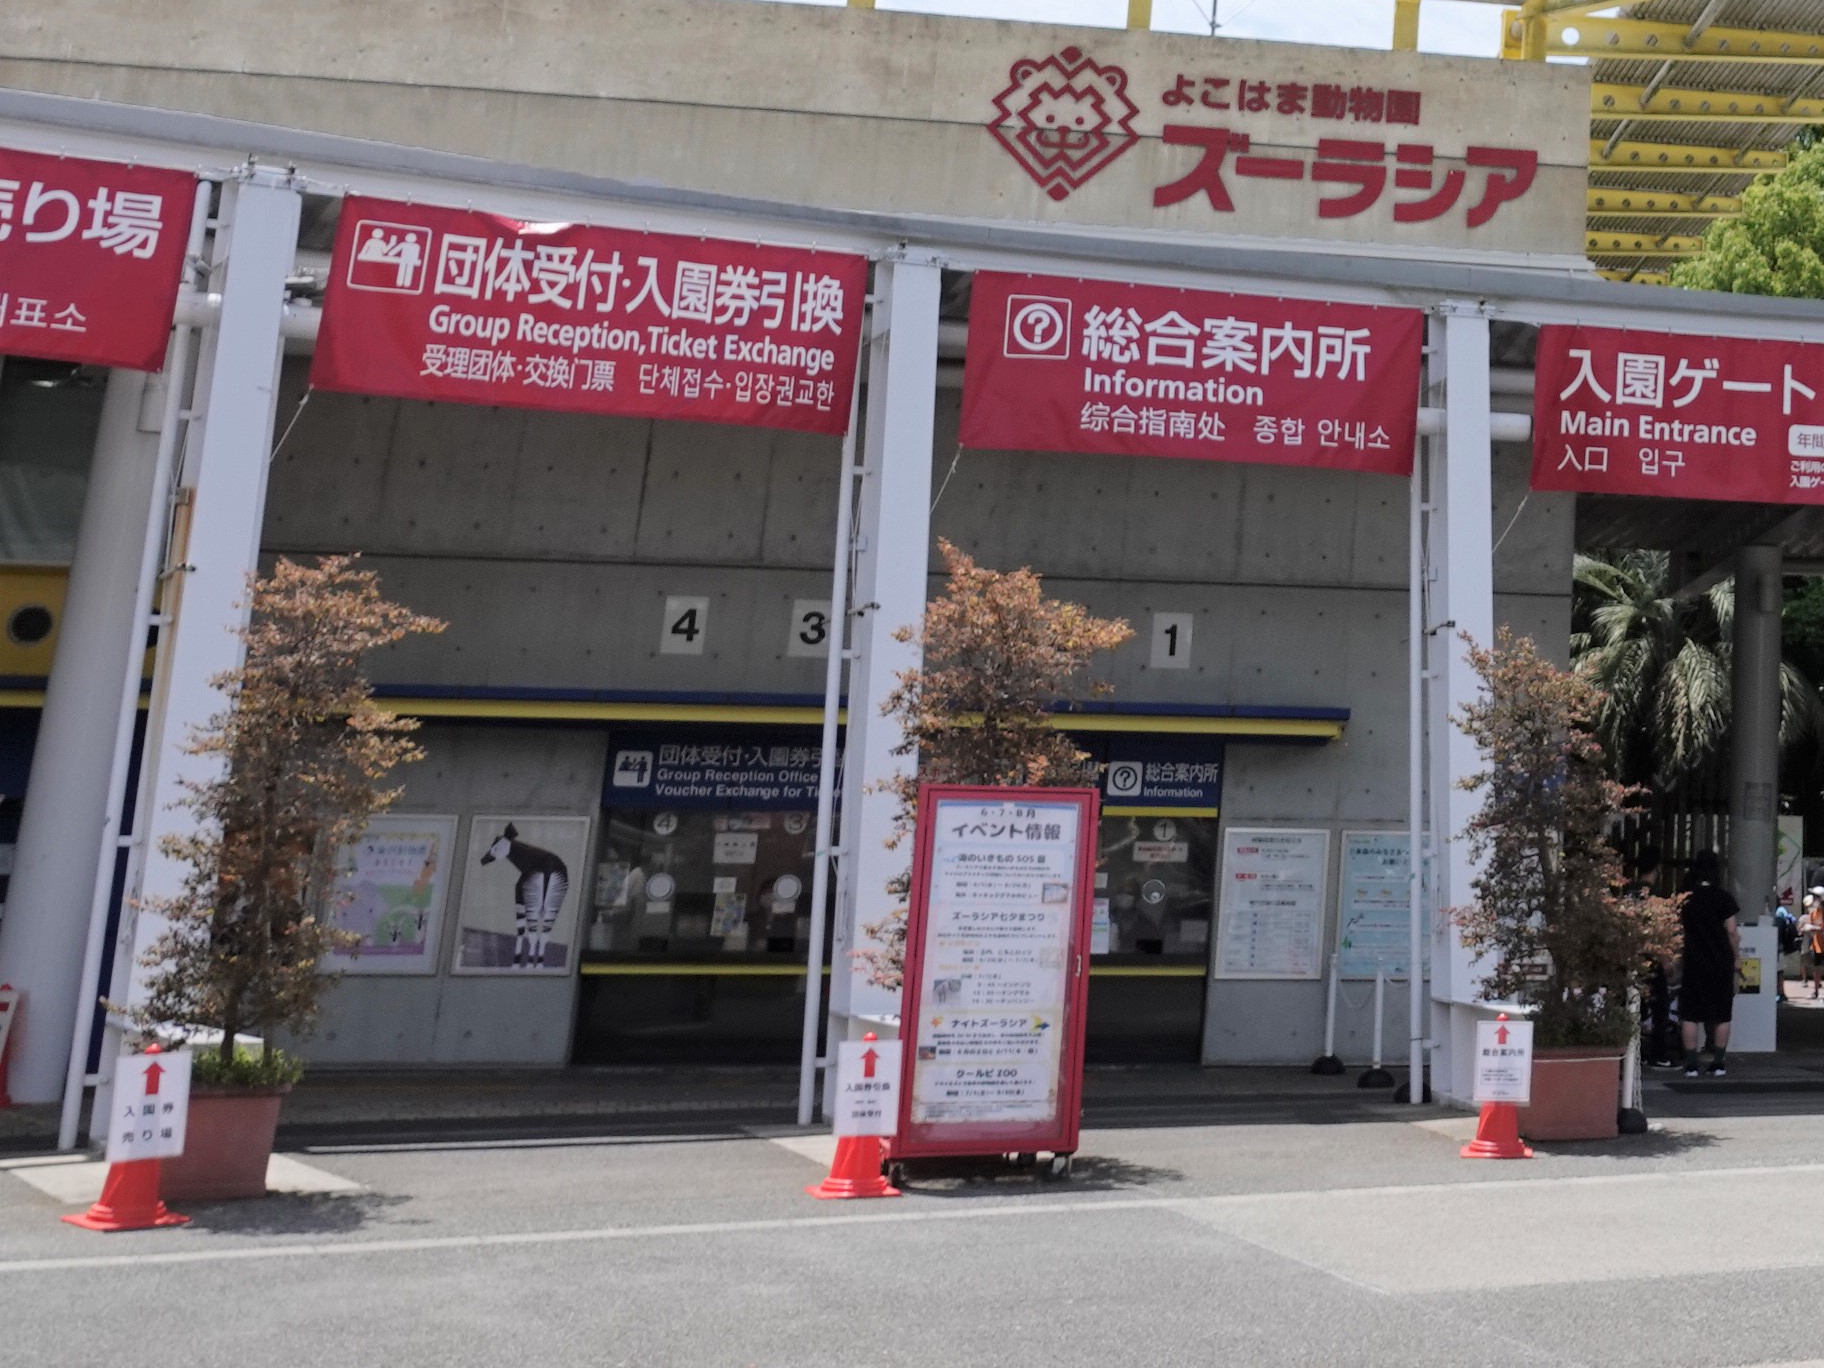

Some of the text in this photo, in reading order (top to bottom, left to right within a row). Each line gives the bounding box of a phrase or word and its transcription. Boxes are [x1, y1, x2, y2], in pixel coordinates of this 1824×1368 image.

[1161, 73, 1422, 125] よこはま動物園
[1153, 123, 1539, 229] ズーラシア
[433, 233, 844, 336] 団体受付・入園券引換
[429, 304, 511, 346] Group
[723, 334, 835, 376] Exchange
[1081, 304, 1372, 381] 総合案内所
[1084, 367, 1264, 406] Information
[1559, 348, 1816, 415] 入園ゲート
[1080, 401, 1226, 442] 综合指南处
[1253, 415, 1391, 451] 종합 안내소
[1560, 410, 1757, 446] Main Entrance
[1557, 443, 1608, 472] 入口
[1638, 447, 1686, 477] 입구
[671, 608, 700, 642] 4
[799, 611, 826, 645] 3
[1164, 624, 1177, 656] 1
[656, 768, 819, 783] Group Reception Office
[1145, 762, 1219, 783] 総合案内所
[655, 784, 712, 796] Voucher
[715, 784, 779, 800] Exchange
[783, 785, 802, 797] for
[1143, 786, 1203, 798] Information
[952, 822, 1062, 841] イベント情報
